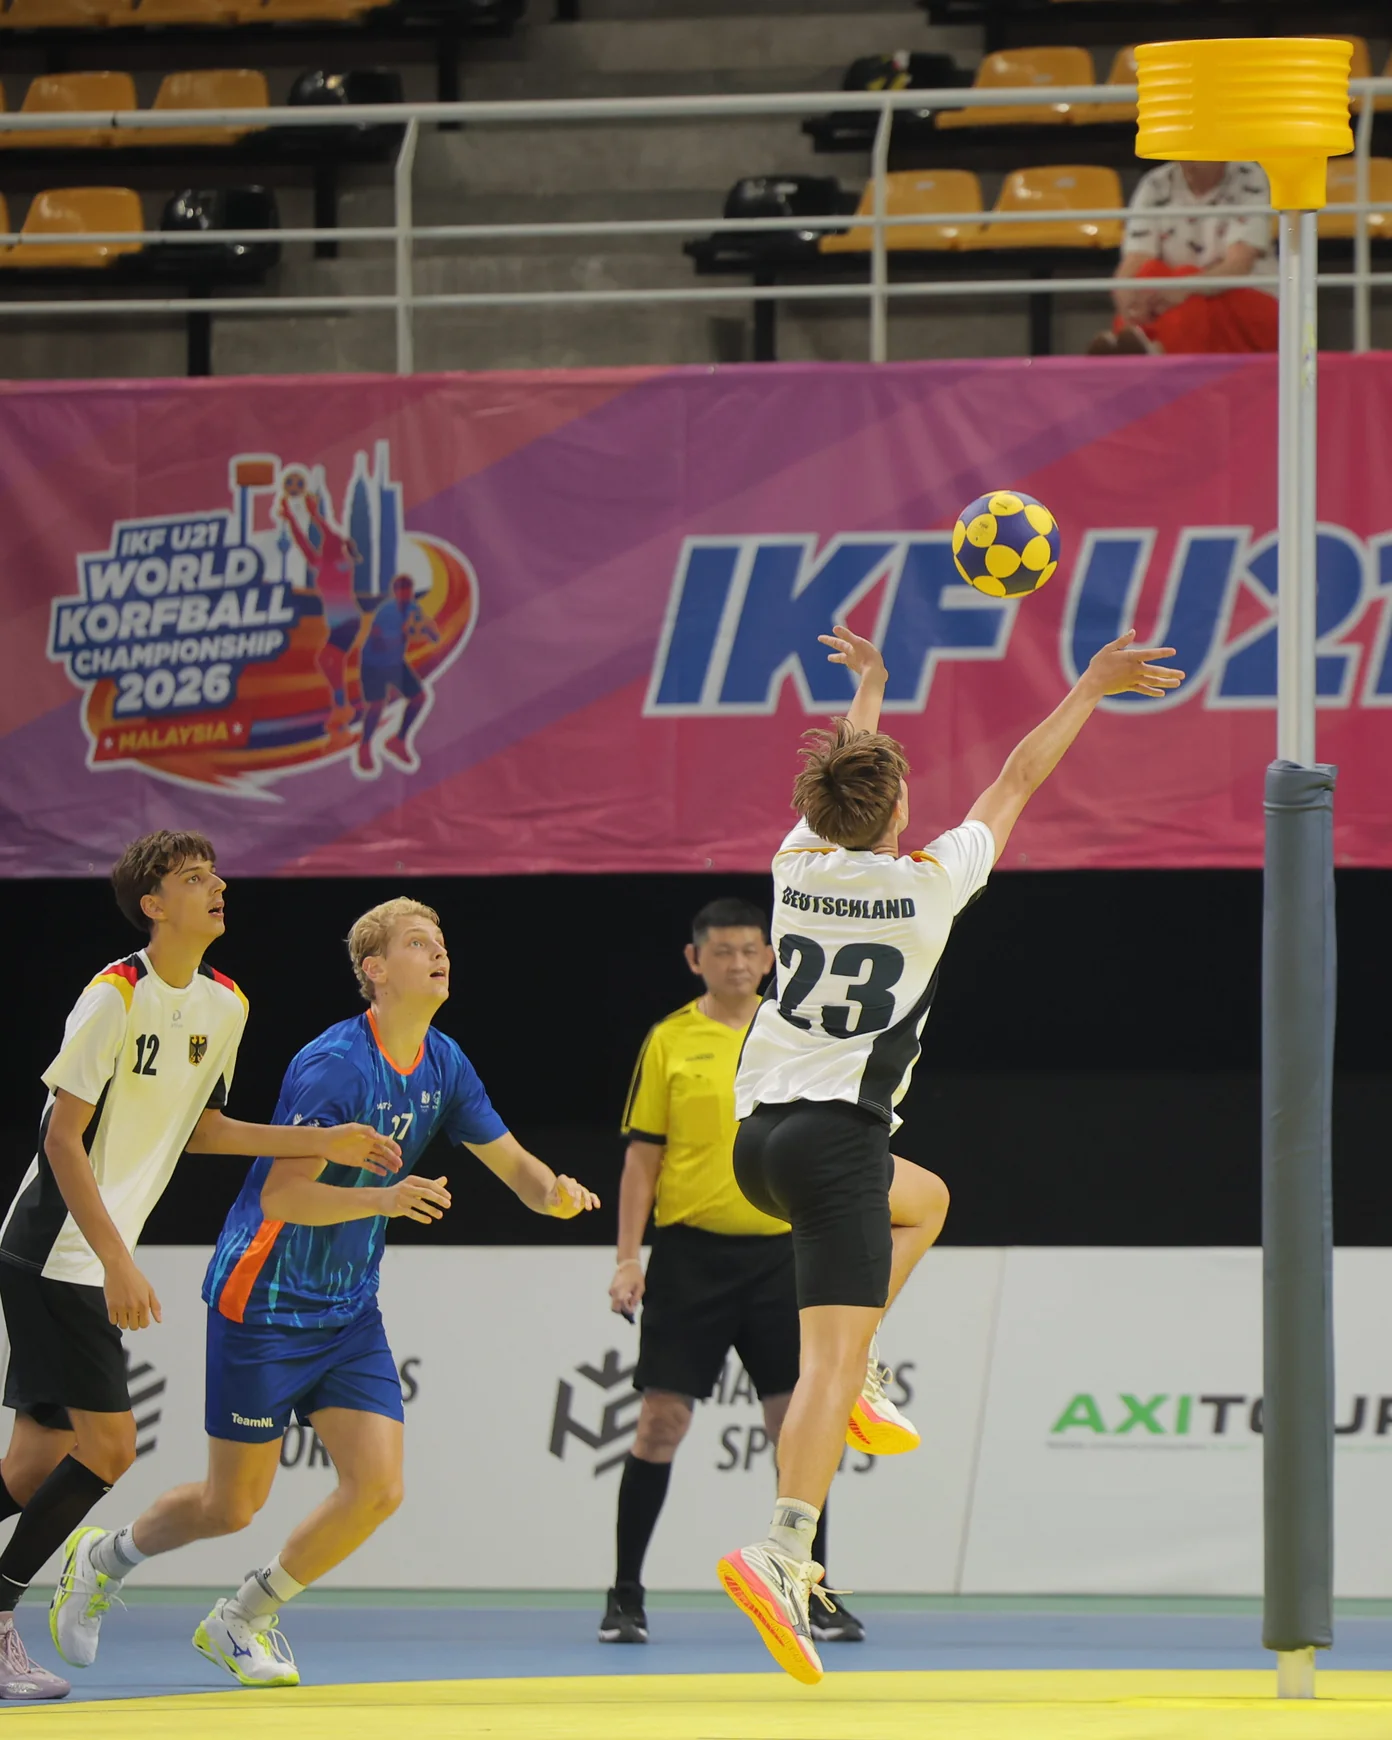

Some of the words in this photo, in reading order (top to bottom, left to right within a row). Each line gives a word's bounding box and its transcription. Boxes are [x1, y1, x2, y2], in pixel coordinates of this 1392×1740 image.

[122, 528, 167, 557] IKF
[170, 521, 220, 551] U21
[88, 548, 258, 600] WORLD
[58, 585, 294, 647] KORFBALL
[643, 531, 1022, 717] IKF
[75, 630, 284, 675] CHAMPIONSHIP
[116, 663, 232, 713] 2026
[118, 721, 229, 752] MALAYSIA
[782, 886, 916, 920] DEUTSCHLAND
[777, 933, 905, 1039] 23
[132, 1033, 160, 1076] 12
[231, 1412, 274, 1428] TeamNL
